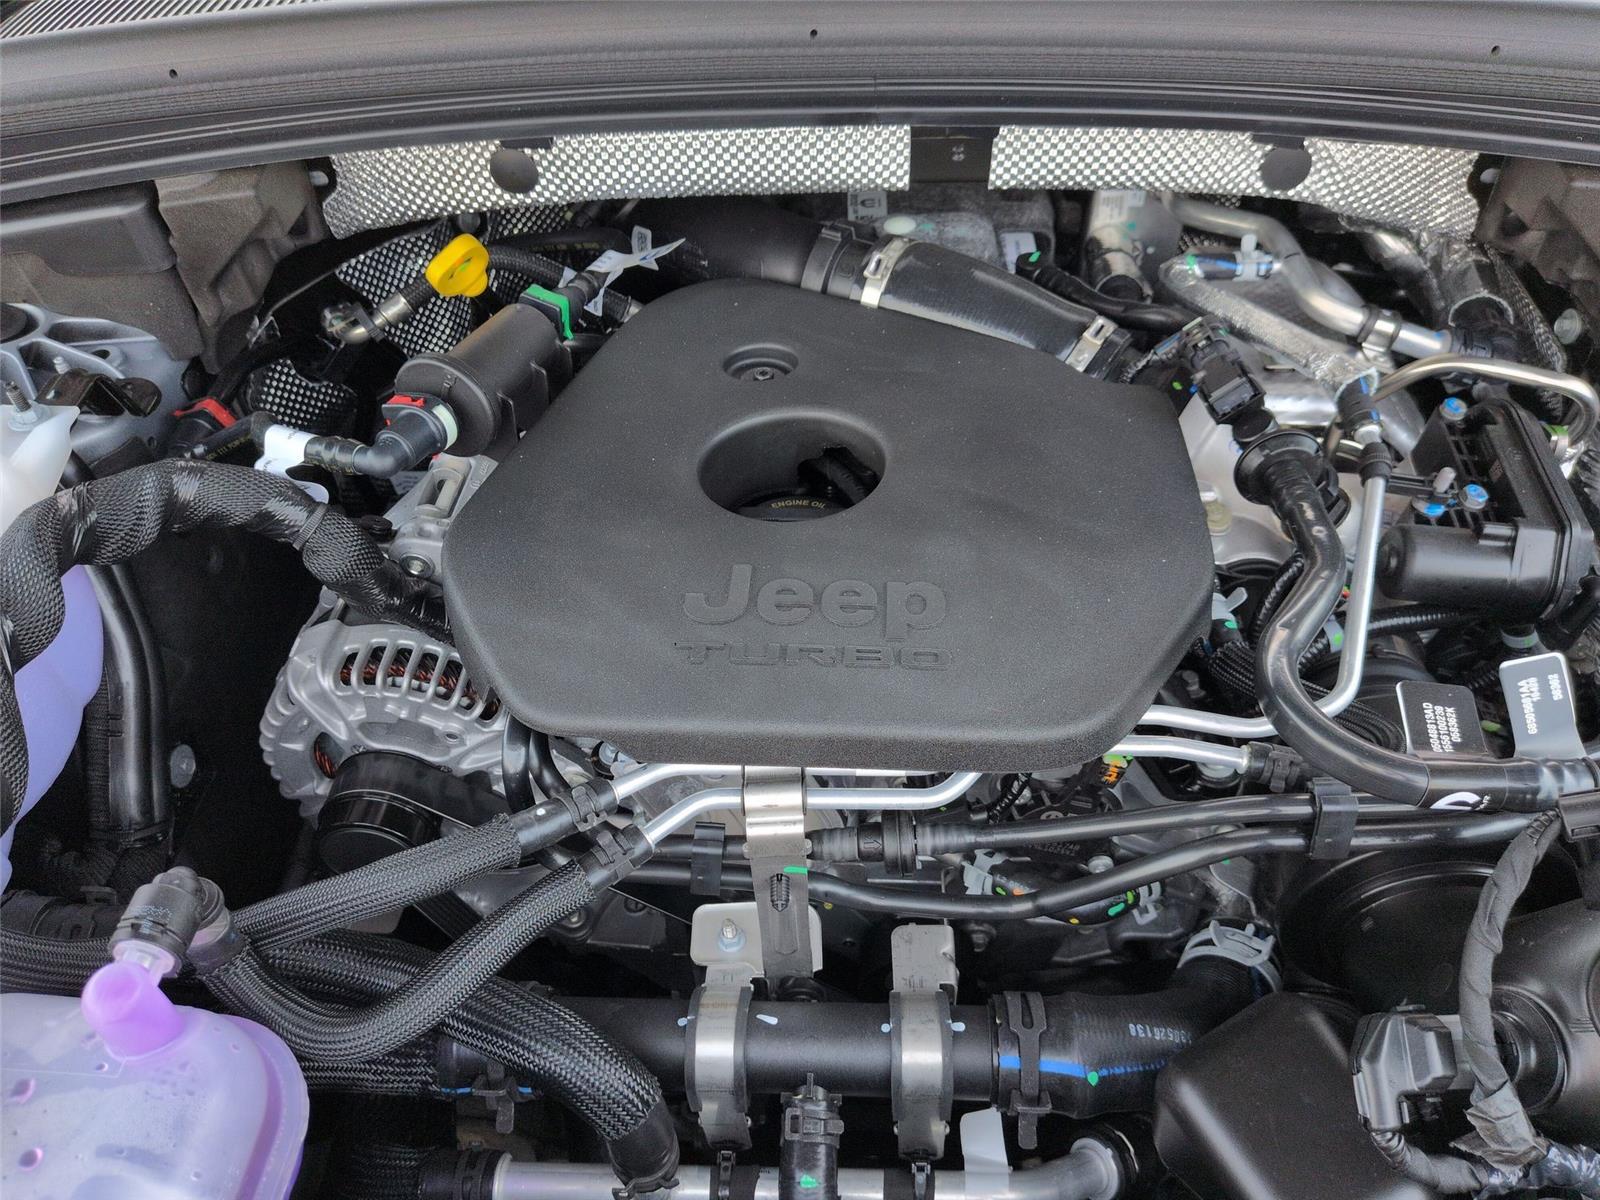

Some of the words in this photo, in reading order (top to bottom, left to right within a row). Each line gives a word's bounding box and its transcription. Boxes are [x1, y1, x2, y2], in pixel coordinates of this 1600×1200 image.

[771, 499, 809, 509] ENGINE
[811, 501, 826, 509] OIL
[682, 563, 948, 642] Jeep
[673, 640, 951, 671] TURBO
